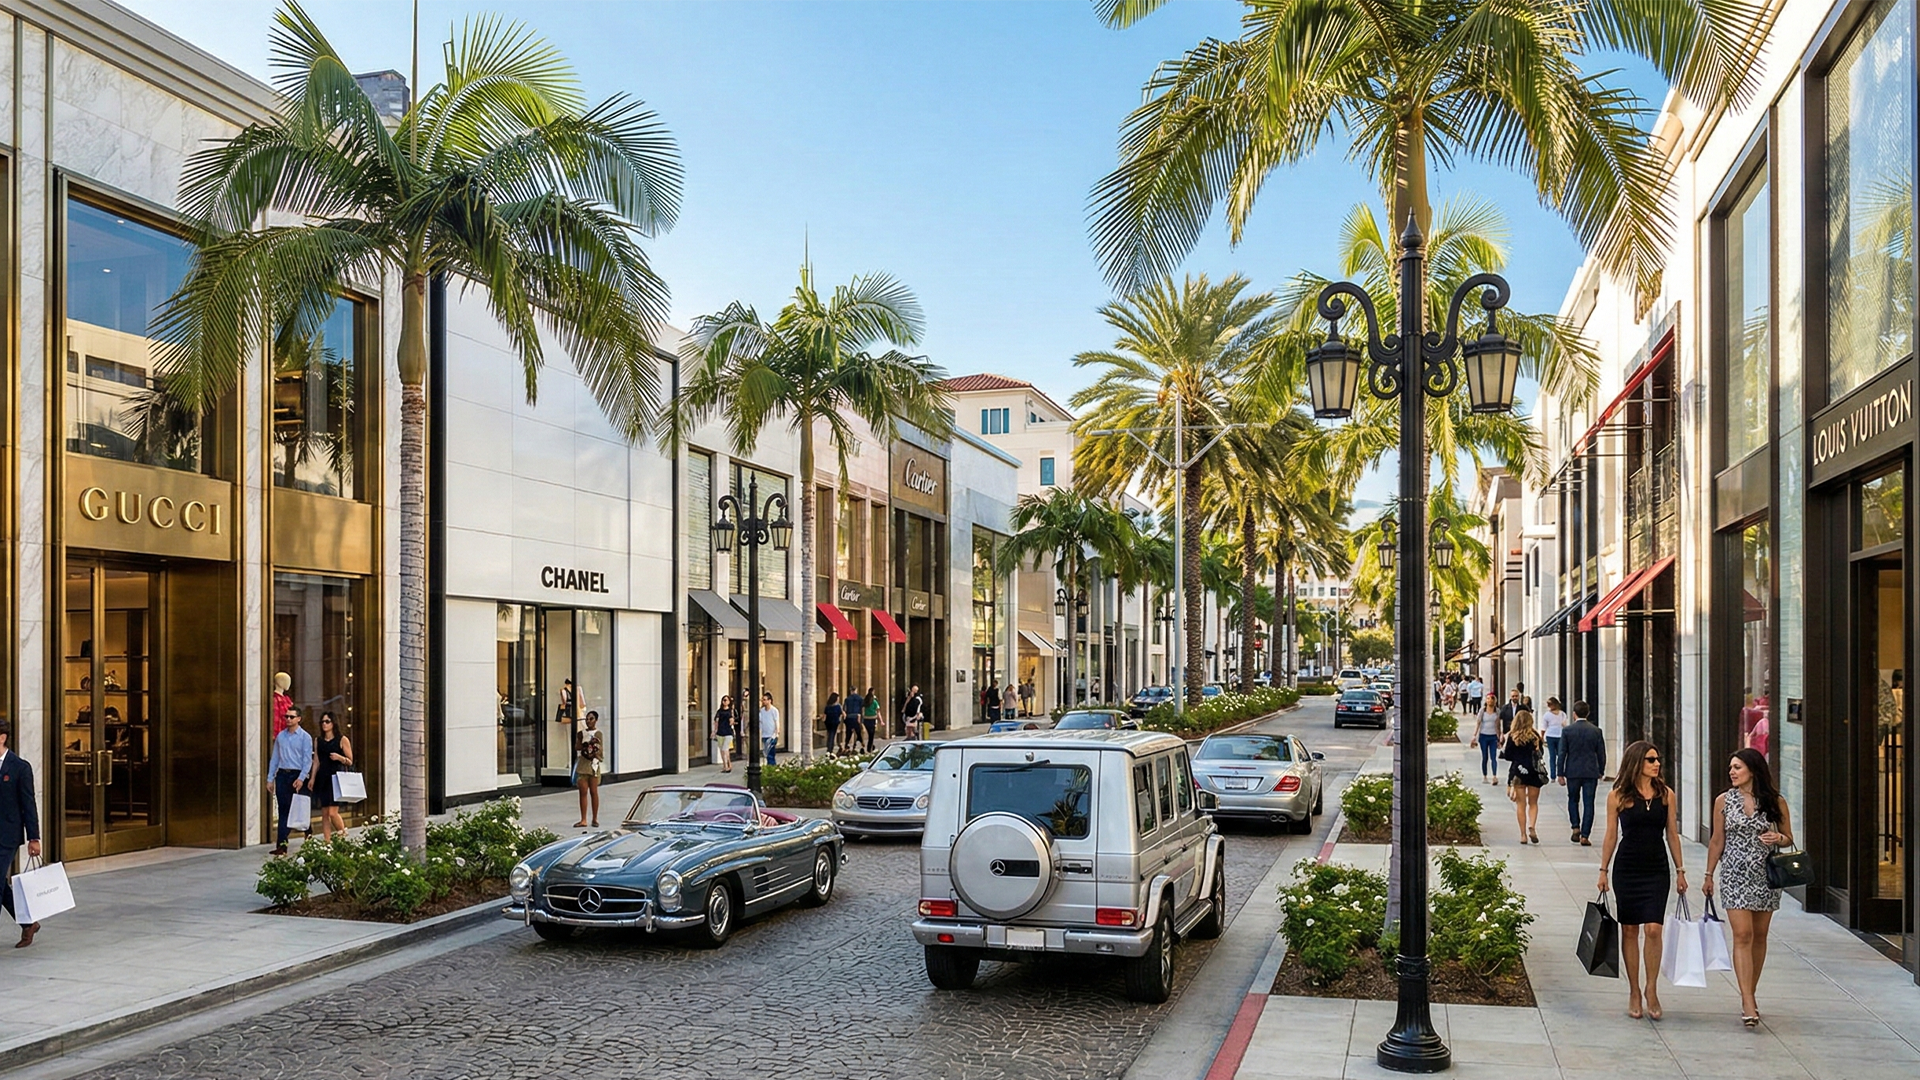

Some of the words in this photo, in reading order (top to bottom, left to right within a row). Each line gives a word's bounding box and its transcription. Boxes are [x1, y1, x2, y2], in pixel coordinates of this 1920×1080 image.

[1813, 418, 1846, 466] LOUIS
[1850, 380, 1911, 447] VUITTON
[904, 458, 938, 495] Cartier
[79, 487, 221, 534] GUCCI
[541, 565, 609, 593] CHANEL
